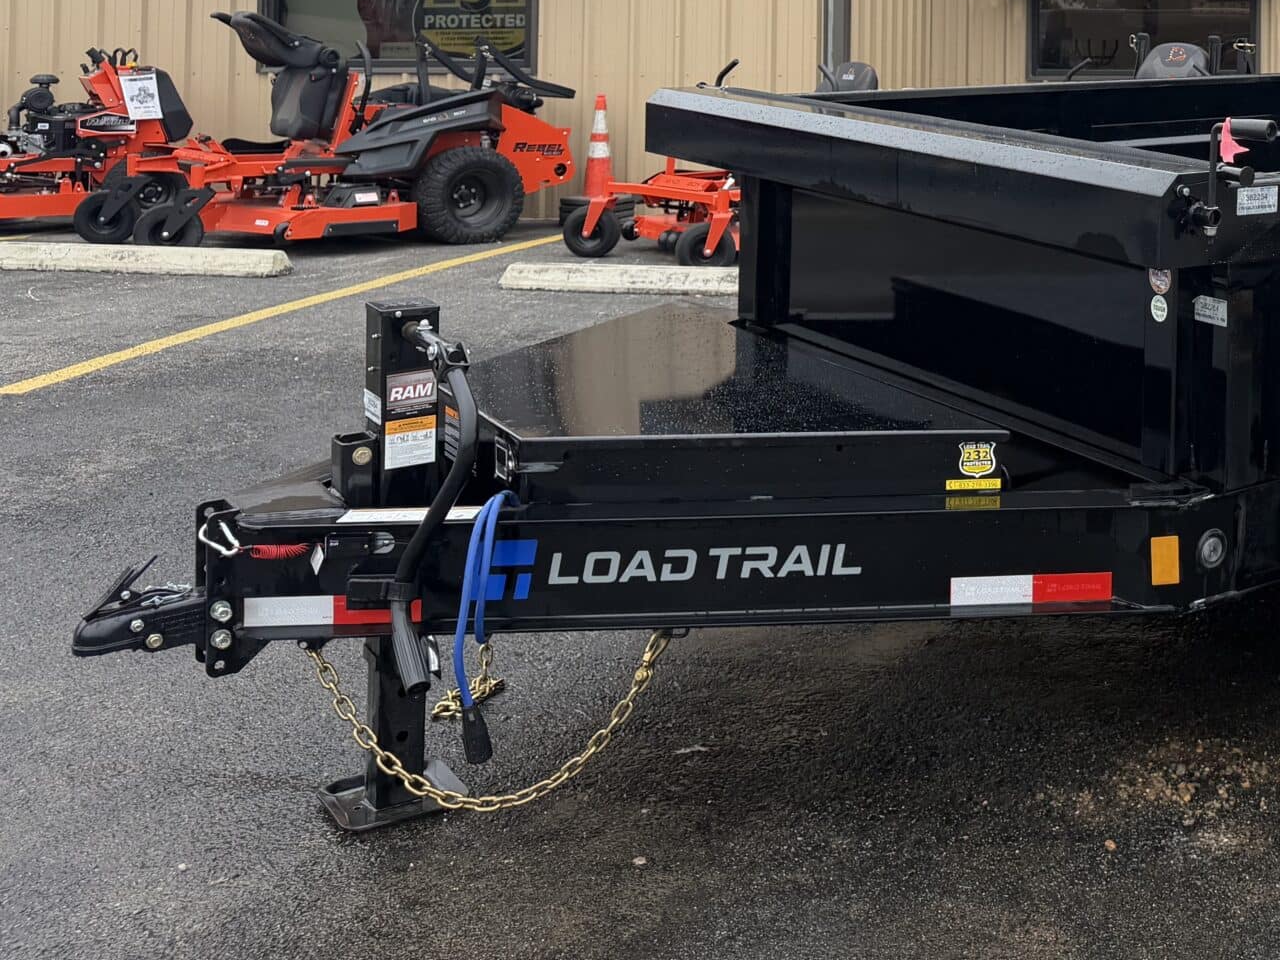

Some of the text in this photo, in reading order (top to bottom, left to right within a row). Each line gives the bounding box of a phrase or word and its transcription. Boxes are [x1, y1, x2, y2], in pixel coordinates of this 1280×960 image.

[424, 13, 526, 28] PROTECTED
[390, 382, 434, 401] RAM
[965, 450, 989, 460] 232
[548, 543, 862, 584] LOAD TRAIL
